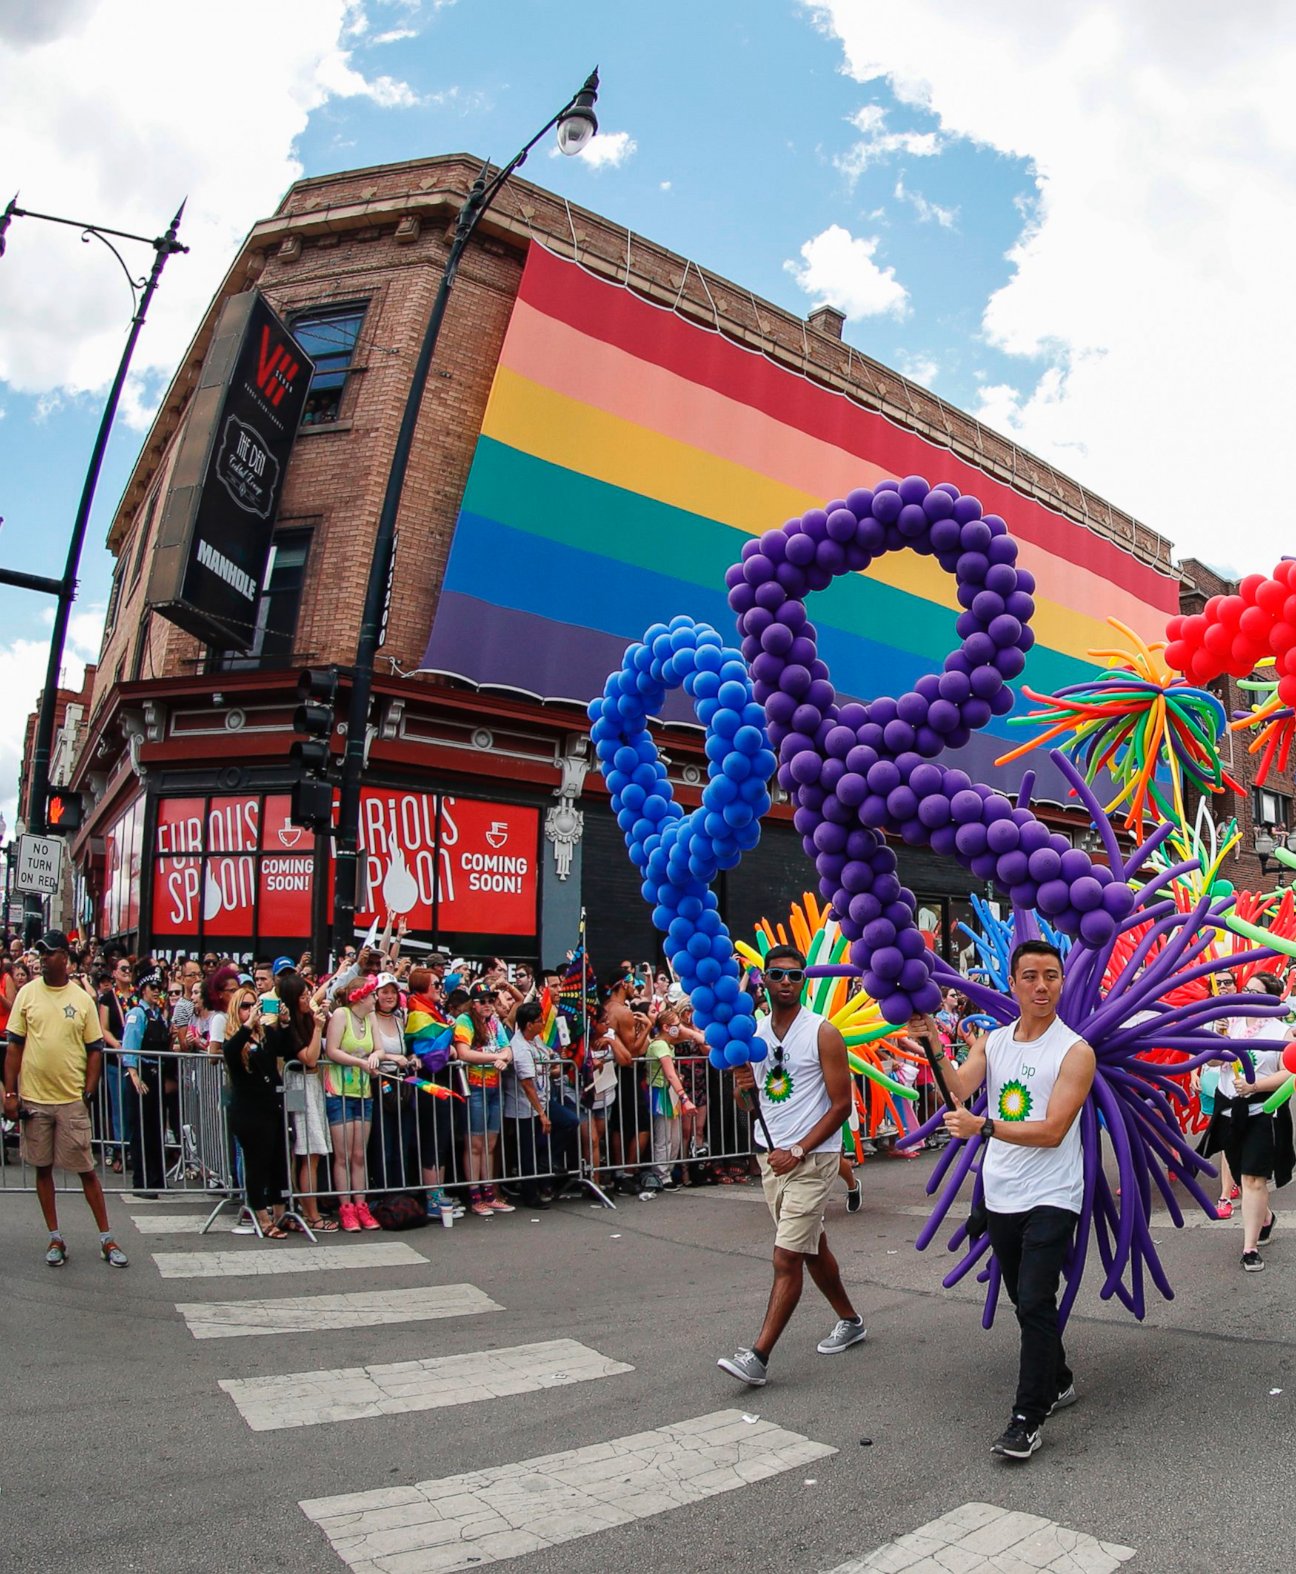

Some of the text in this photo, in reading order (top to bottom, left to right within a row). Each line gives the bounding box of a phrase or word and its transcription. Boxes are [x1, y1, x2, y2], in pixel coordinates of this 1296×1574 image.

[237, 431, 266, 477] THE DEN
[197, 538, 257, 602] MANHOLE
[158, 801, 259, 874] FUROUS
[33, 843, 48, 855] NO
[28, 857, 52, 871] TURN
[261, 859, 314, 874] COMING
[461, 853, 528, 875] COMING
[21, 872, 55, 888] ON RED
[267, 876, 309, 891] SOON!
[469, 873, 522, 894] SOON!
[1021, 1062, 1036, 1078] bp
